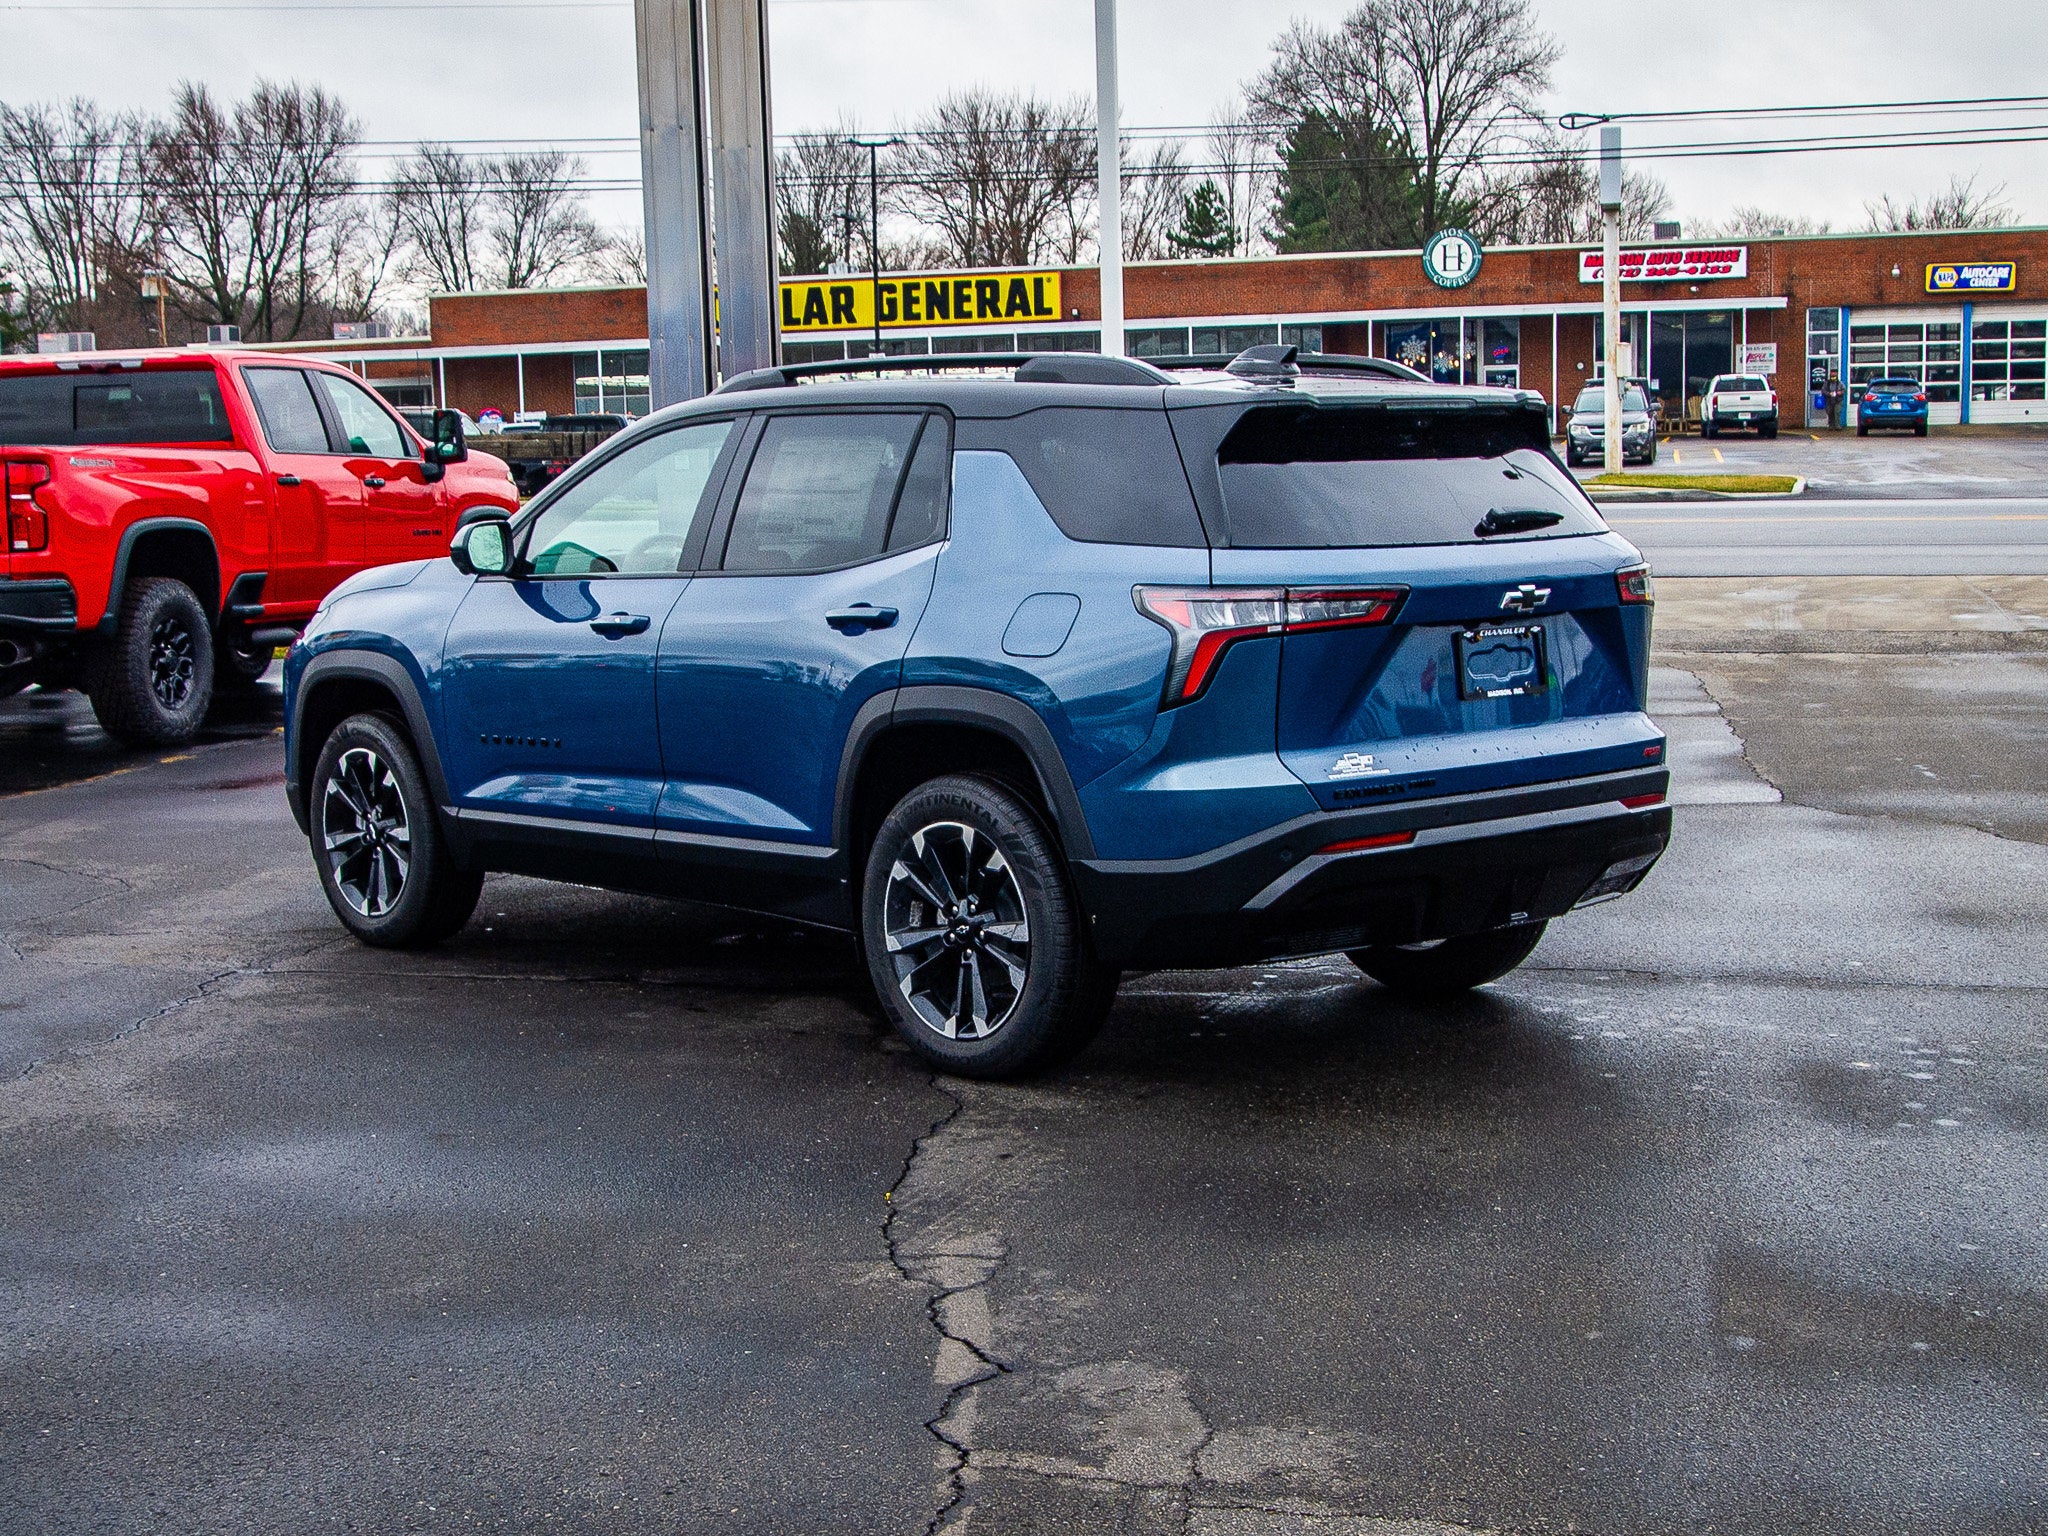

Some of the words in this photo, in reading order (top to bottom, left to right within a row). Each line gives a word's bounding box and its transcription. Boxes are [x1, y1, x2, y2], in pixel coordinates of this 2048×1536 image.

[1440, 228, 1464, 238] HOS
[1584, 252, 1646, 268] MASON
[1647, 251, 1682, 265] AUTO
[1683, 249, 1742, 264] SERVICE
[1433, 274, 1470, 287] COFFEE
[1969, 278, 2000, 287] CENTER
[782, 286, 857, 326] LAR
[878, 277, 1053, 322] GENERAL
[1479, 626, 1526, 637] CHANDLER
[480, 734, 562, 749] EQUINOX
[1333, 783, 1405, 800] EQUINOX
[903, 793, 1000, 829] NTINENTAL
